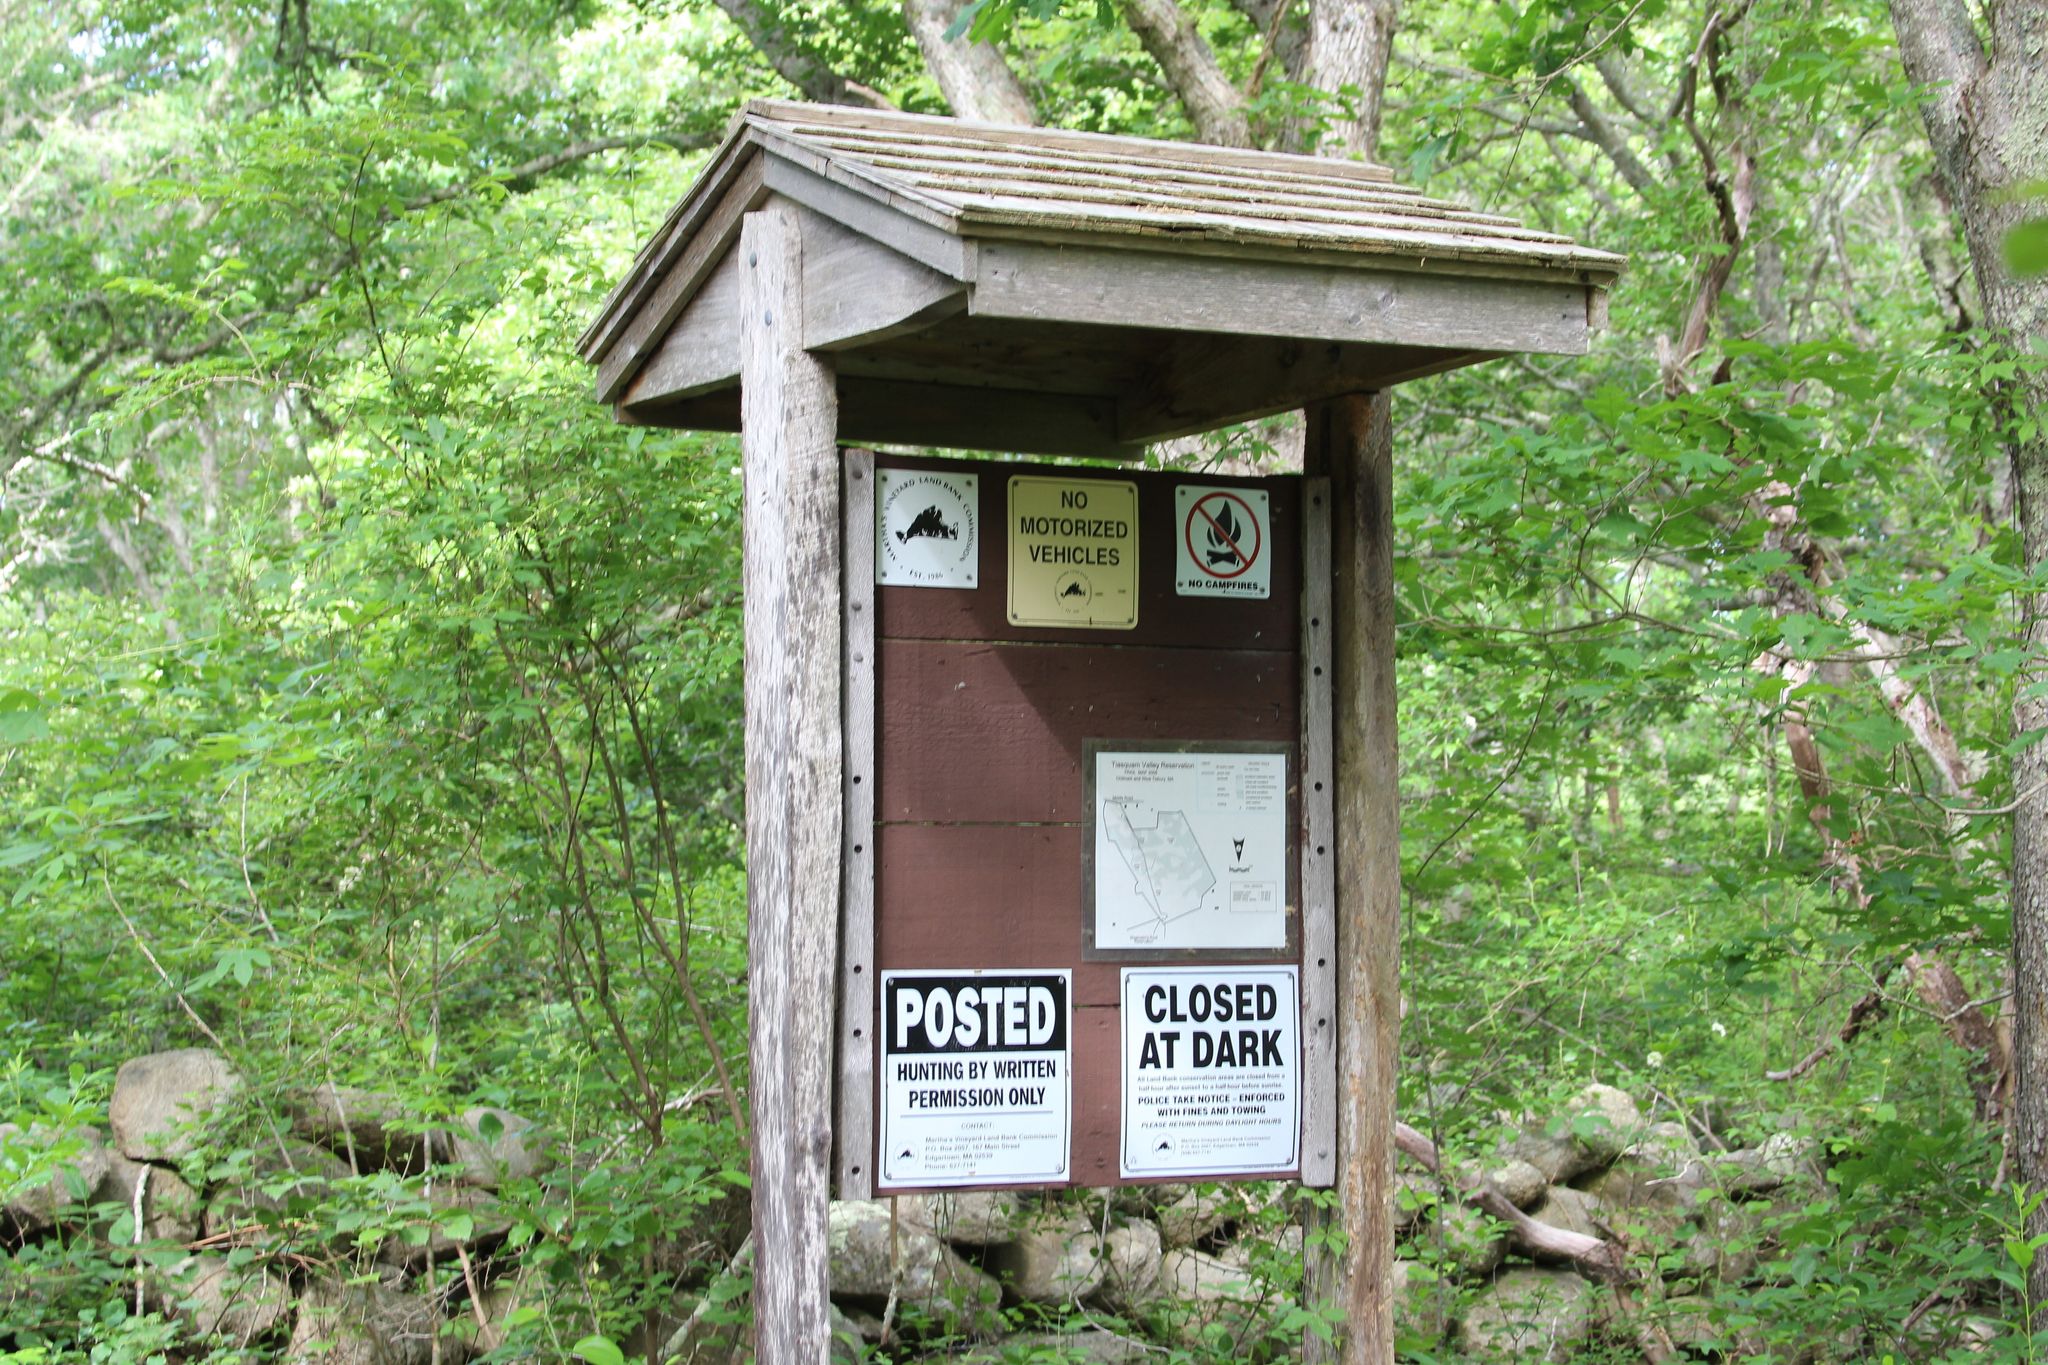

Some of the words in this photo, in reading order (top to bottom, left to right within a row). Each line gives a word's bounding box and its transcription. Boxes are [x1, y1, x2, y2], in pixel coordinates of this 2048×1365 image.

[919, 477, 942, 487] LAND
[943, 482, 962, 503] BANK
[1061, 490, 1089, 509] NO
[1020, 516, 1128, 539] MOTORIZED
[1029, 544, 1120, 566] VEHICLES
[1188, 579, 1203, 588] NO
[1205, 580, 1258, 590] CAMPFIRES
[1144, 984, 1277, 1023] CLOSED
[897, 986, 1056, 1048] POSTED
[1139, 1031, 1181, 1069] AT
[1192, 1029, 1284, 1068] DARK
[897, 1061, 964, 1081] HUNTING
[968, 1061, 988, 1080] BY
[993, 1059, 1056, 1079] WRITTEN
[909, 1088, 1004, 1108] PERMISSION
[1008, 1087, 1045, 1106] ONLY
[1138, 1096, 1170, 1105] POLICE
[1173, 1094, 1195, 1104] TAKE
[1198, 1094, 1231, 1104] NOTICE
[1239, 1092, 1285, 1102] ENFORCED
[1158, 1108, 1180, 1116] WITH
[1183, 1107, 1208, 1116] FINES
[1210, 1106, 1229, 1115] AND
[1232, 1105, 1266, 1114] TOWING
[955, 1135, 982, 1144] Vineyard
